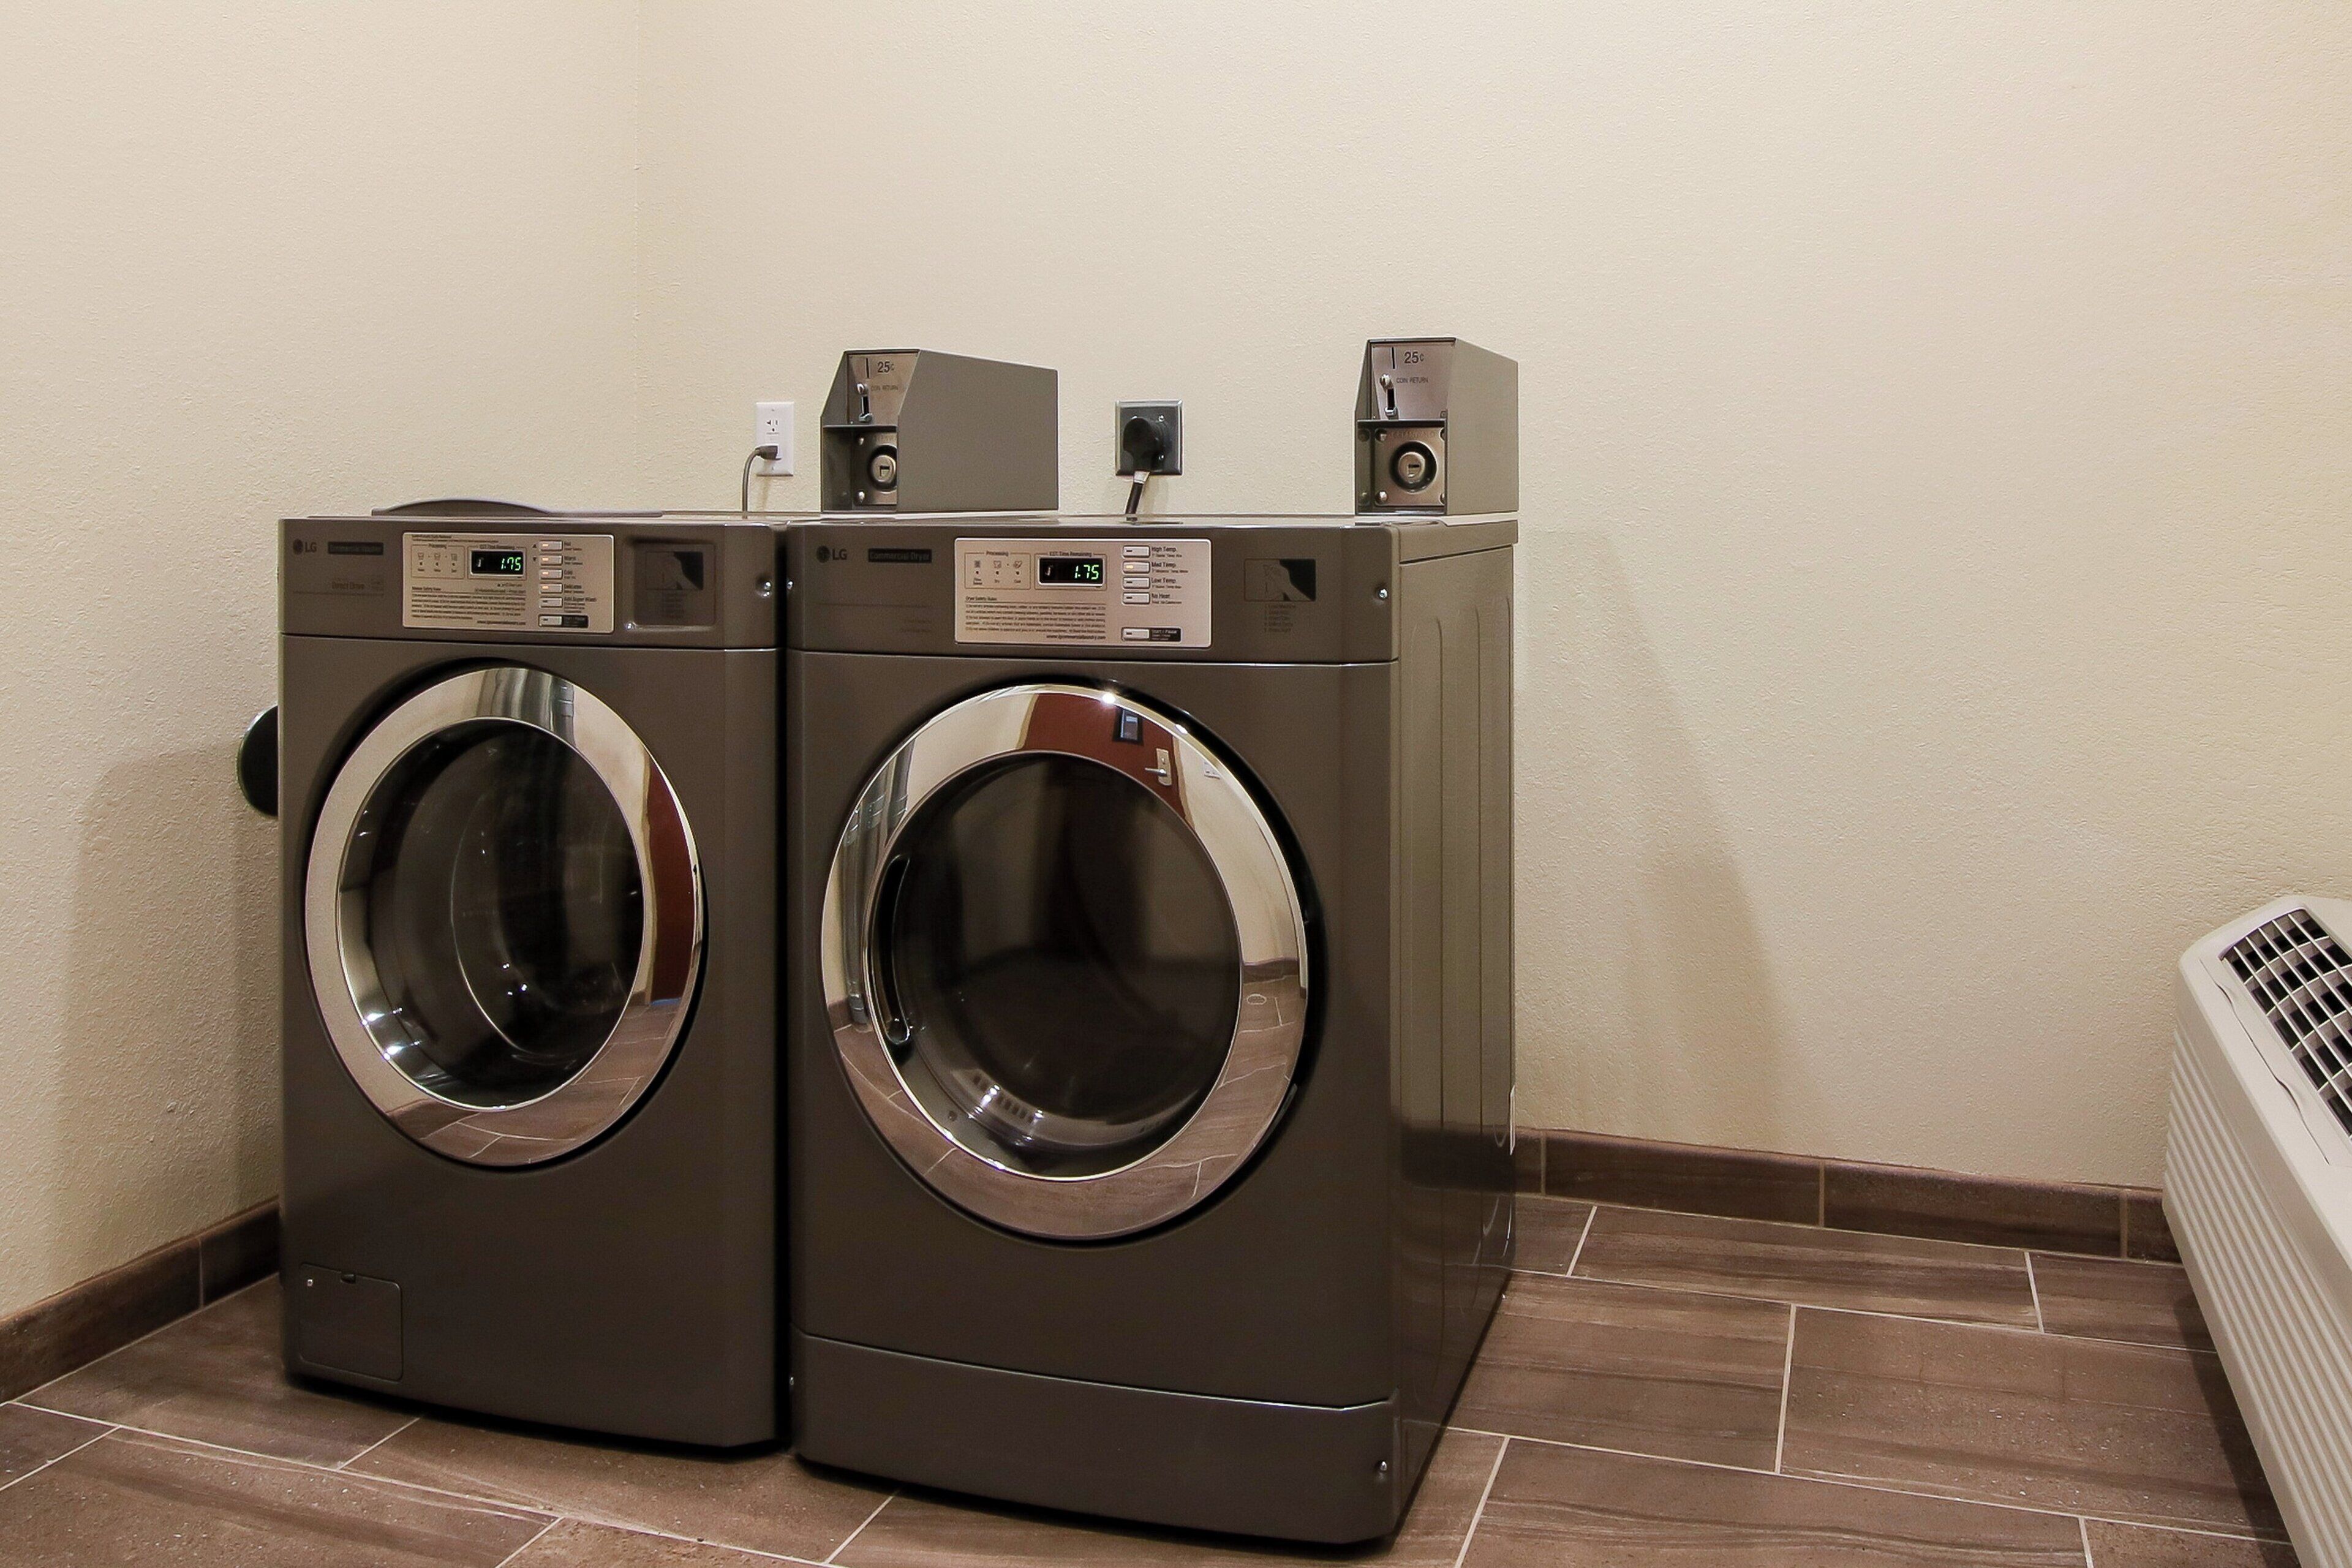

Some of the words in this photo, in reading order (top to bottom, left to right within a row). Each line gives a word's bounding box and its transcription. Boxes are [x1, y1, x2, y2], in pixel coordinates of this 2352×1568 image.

[1404, 351, 1424, 364] 25¢
[304, 541, 317, 552] LG
[832, 548, 848, 560] LG
[501, 556, 522, 571] 1.75
[1074, 564, 1099, 580] 1.75
